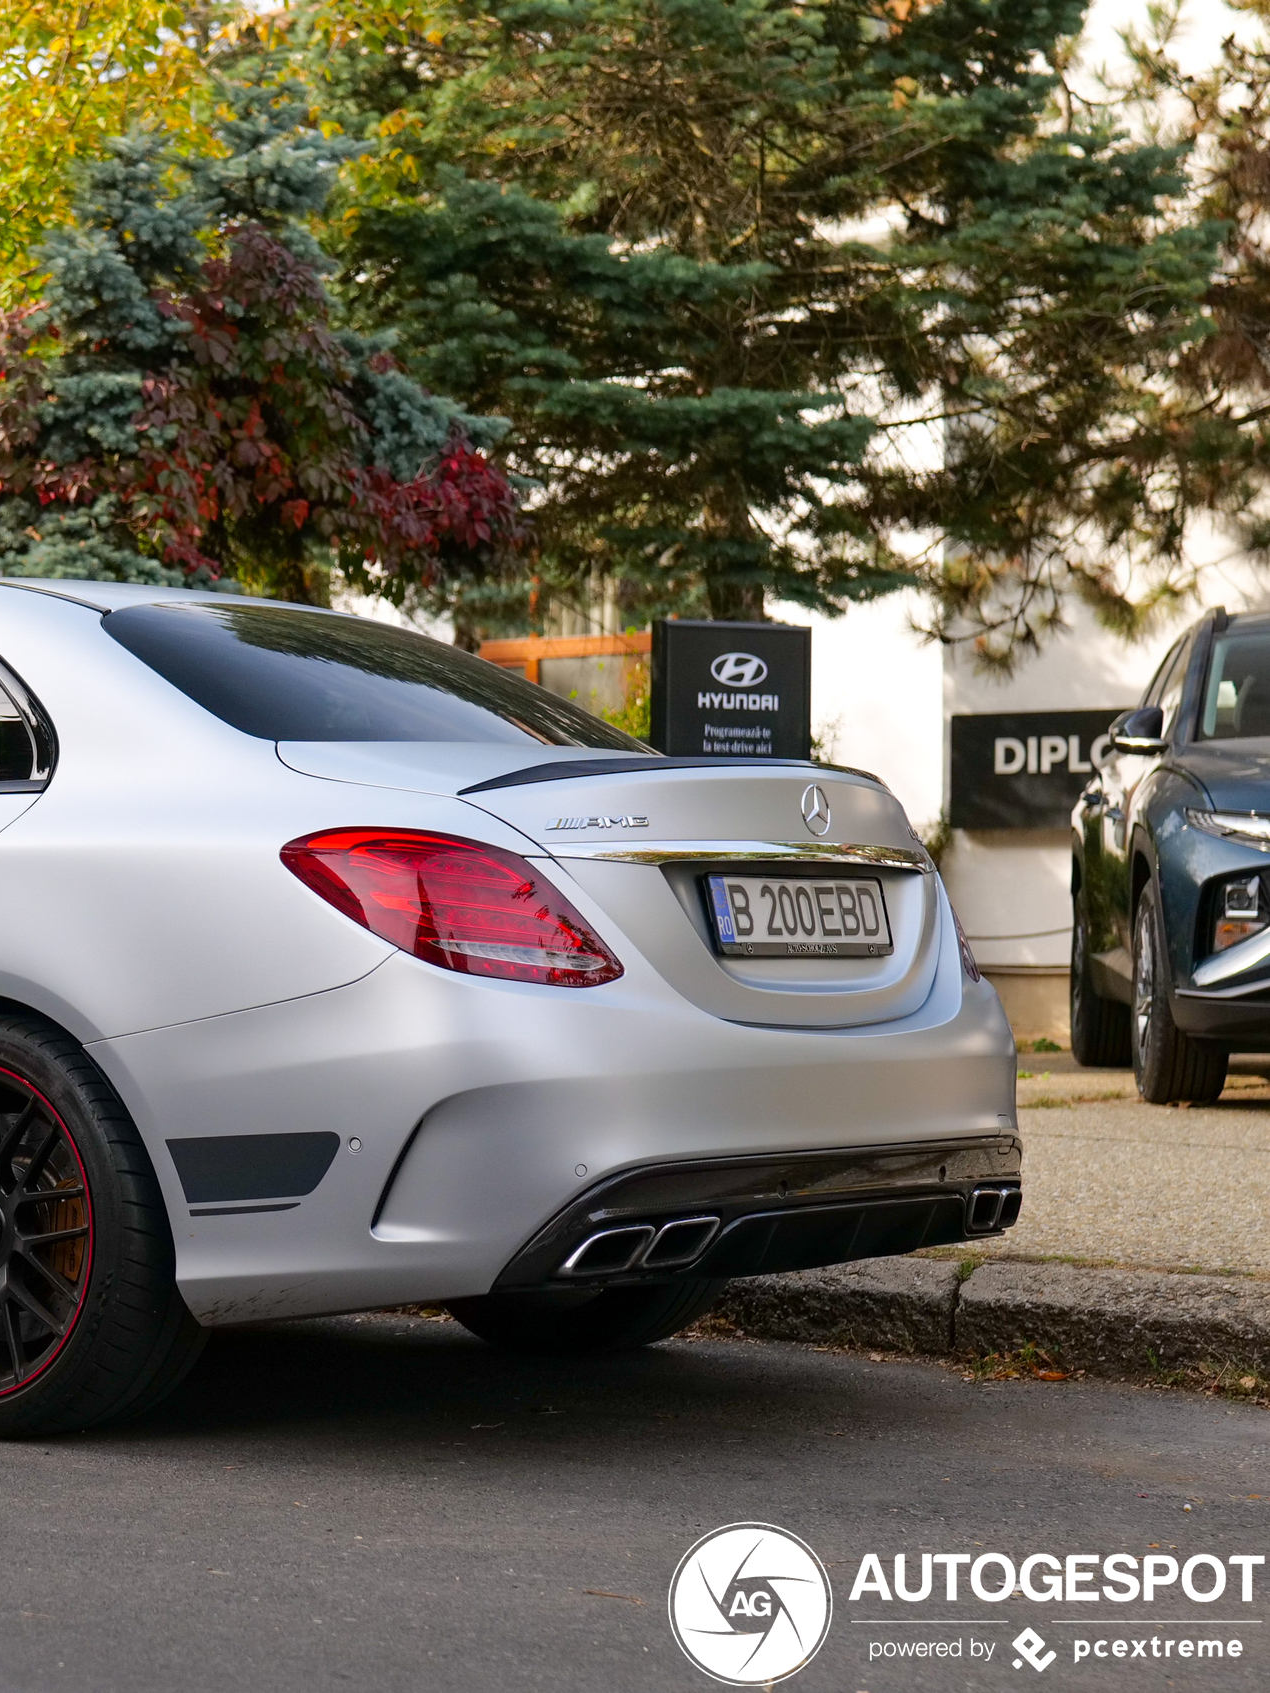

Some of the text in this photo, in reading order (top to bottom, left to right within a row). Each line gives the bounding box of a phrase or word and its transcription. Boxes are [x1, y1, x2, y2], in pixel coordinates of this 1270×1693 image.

[697, 691, 780, 712] HYUNDAI
[703, 739, 712, 752] la
[755, 741, 772, 754] aici
[580, 815, 650, 830] AMG
[728, 884, 754, 936] B
[717, 915, 733, 936] RO
